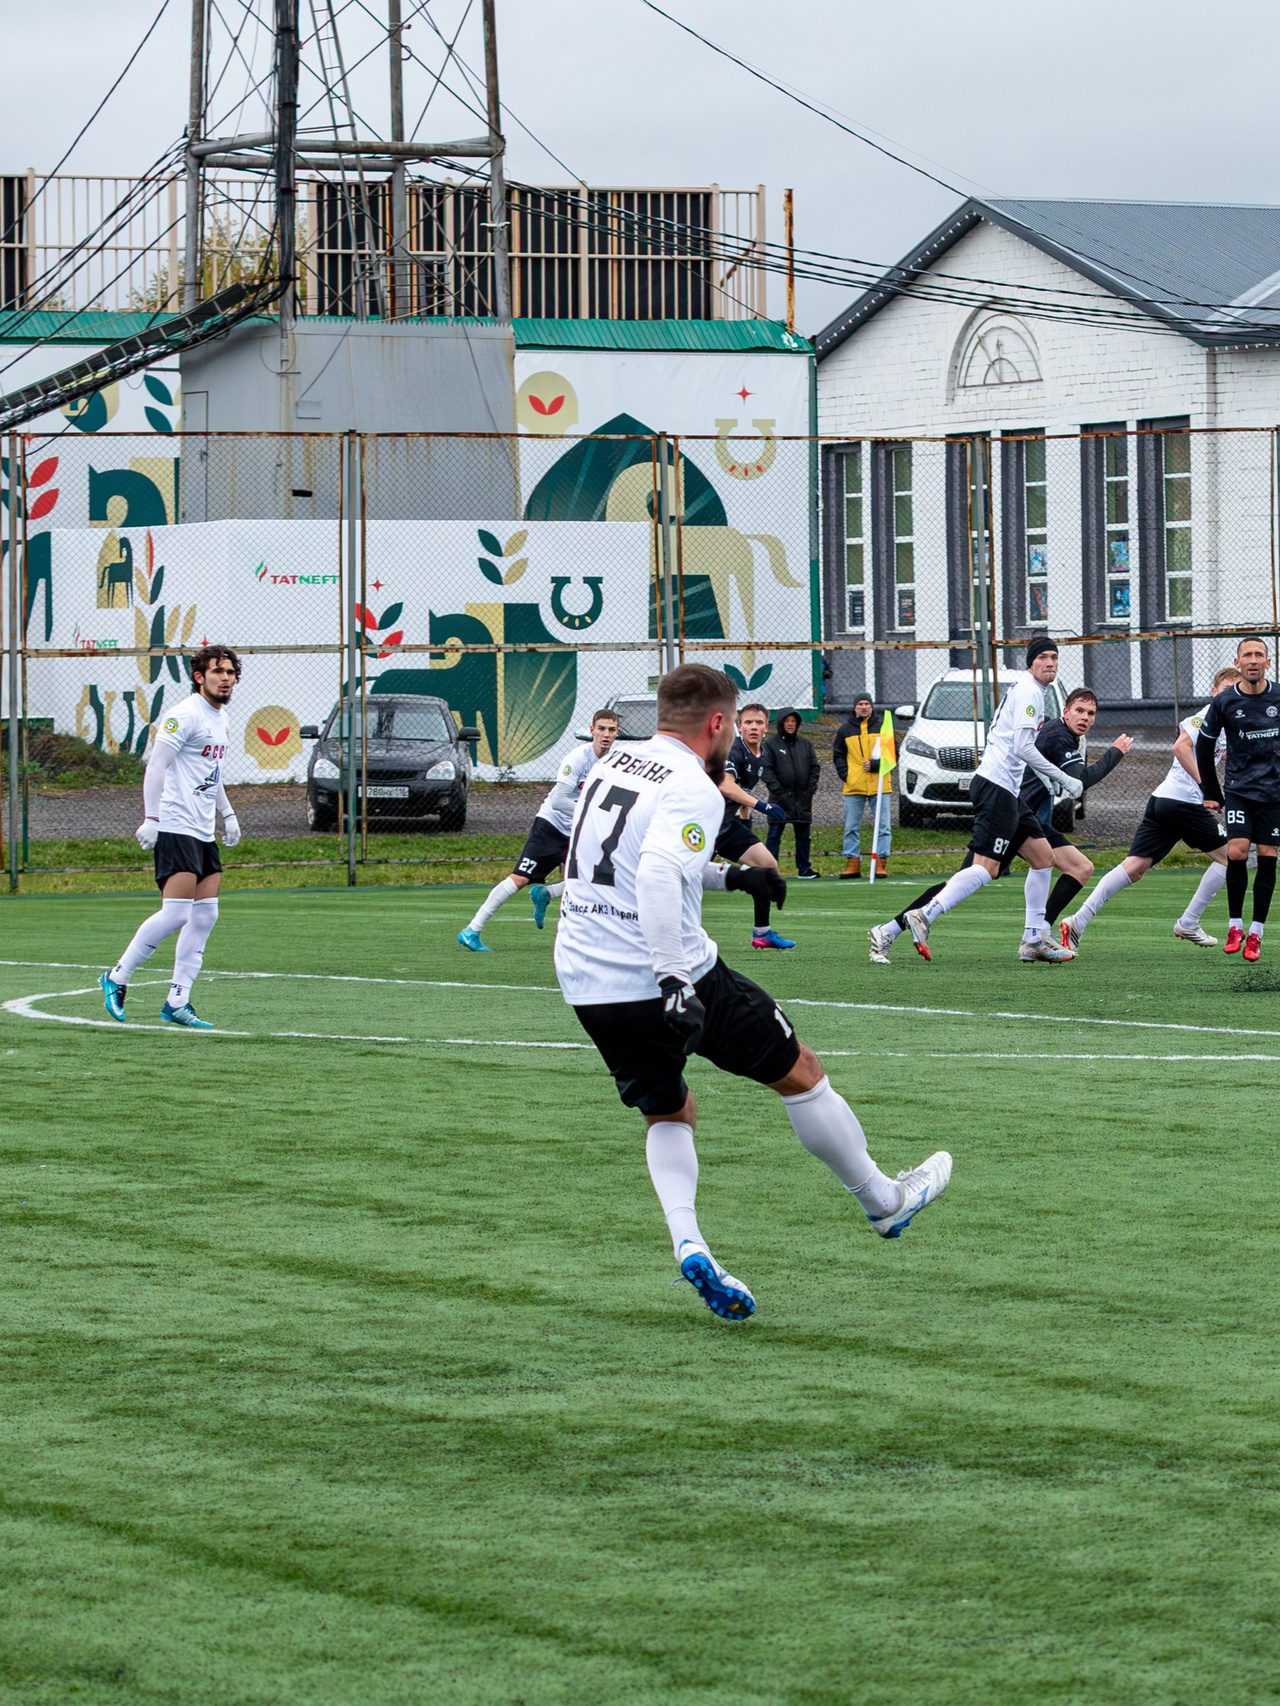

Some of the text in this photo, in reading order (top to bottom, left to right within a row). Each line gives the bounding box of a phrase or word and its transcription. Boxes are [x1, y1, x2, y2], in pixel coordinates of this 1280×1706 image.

[270, 574, 340, 585] TATNEFT
[201, 745, 228, 760] ССС
[1227, 810, 1245, 824] 85
[567, 778, 641, 888] 17
[993, 837, 1010, 855] 87
[518, 857, 538, 875] 27
